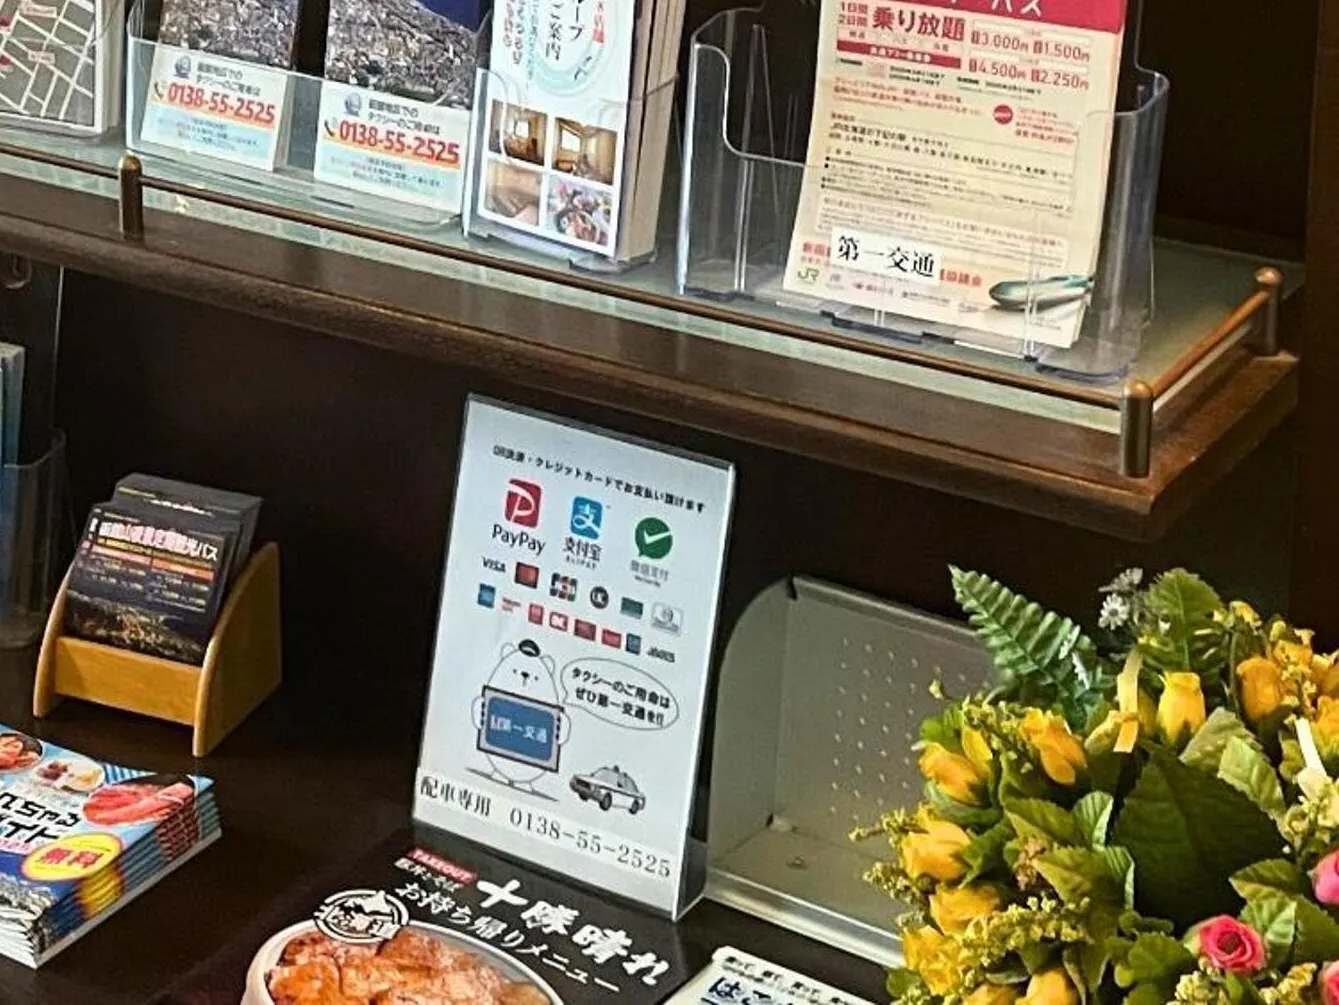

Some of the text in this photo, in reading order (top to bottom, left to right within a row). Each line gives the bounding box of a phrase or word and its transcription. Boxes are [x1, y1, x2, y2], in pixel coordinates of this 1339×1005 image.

[872, 6, 965, 42] 乗り放題
[168, 82, 276, 125] 0138-55-2525
[340, 119, 460, 165] 0138-55-2525
[837, 235, 935, 278] 第一交通
[492, 523, 546, 557] PayPay
[482, 556, 507, 573] VISA
[420, 775, 493, 818] 配車専用
[509, 807, 672, 879] 0138-55-2525
[394, 882, 621, 993] お持ち帰りメニュー
